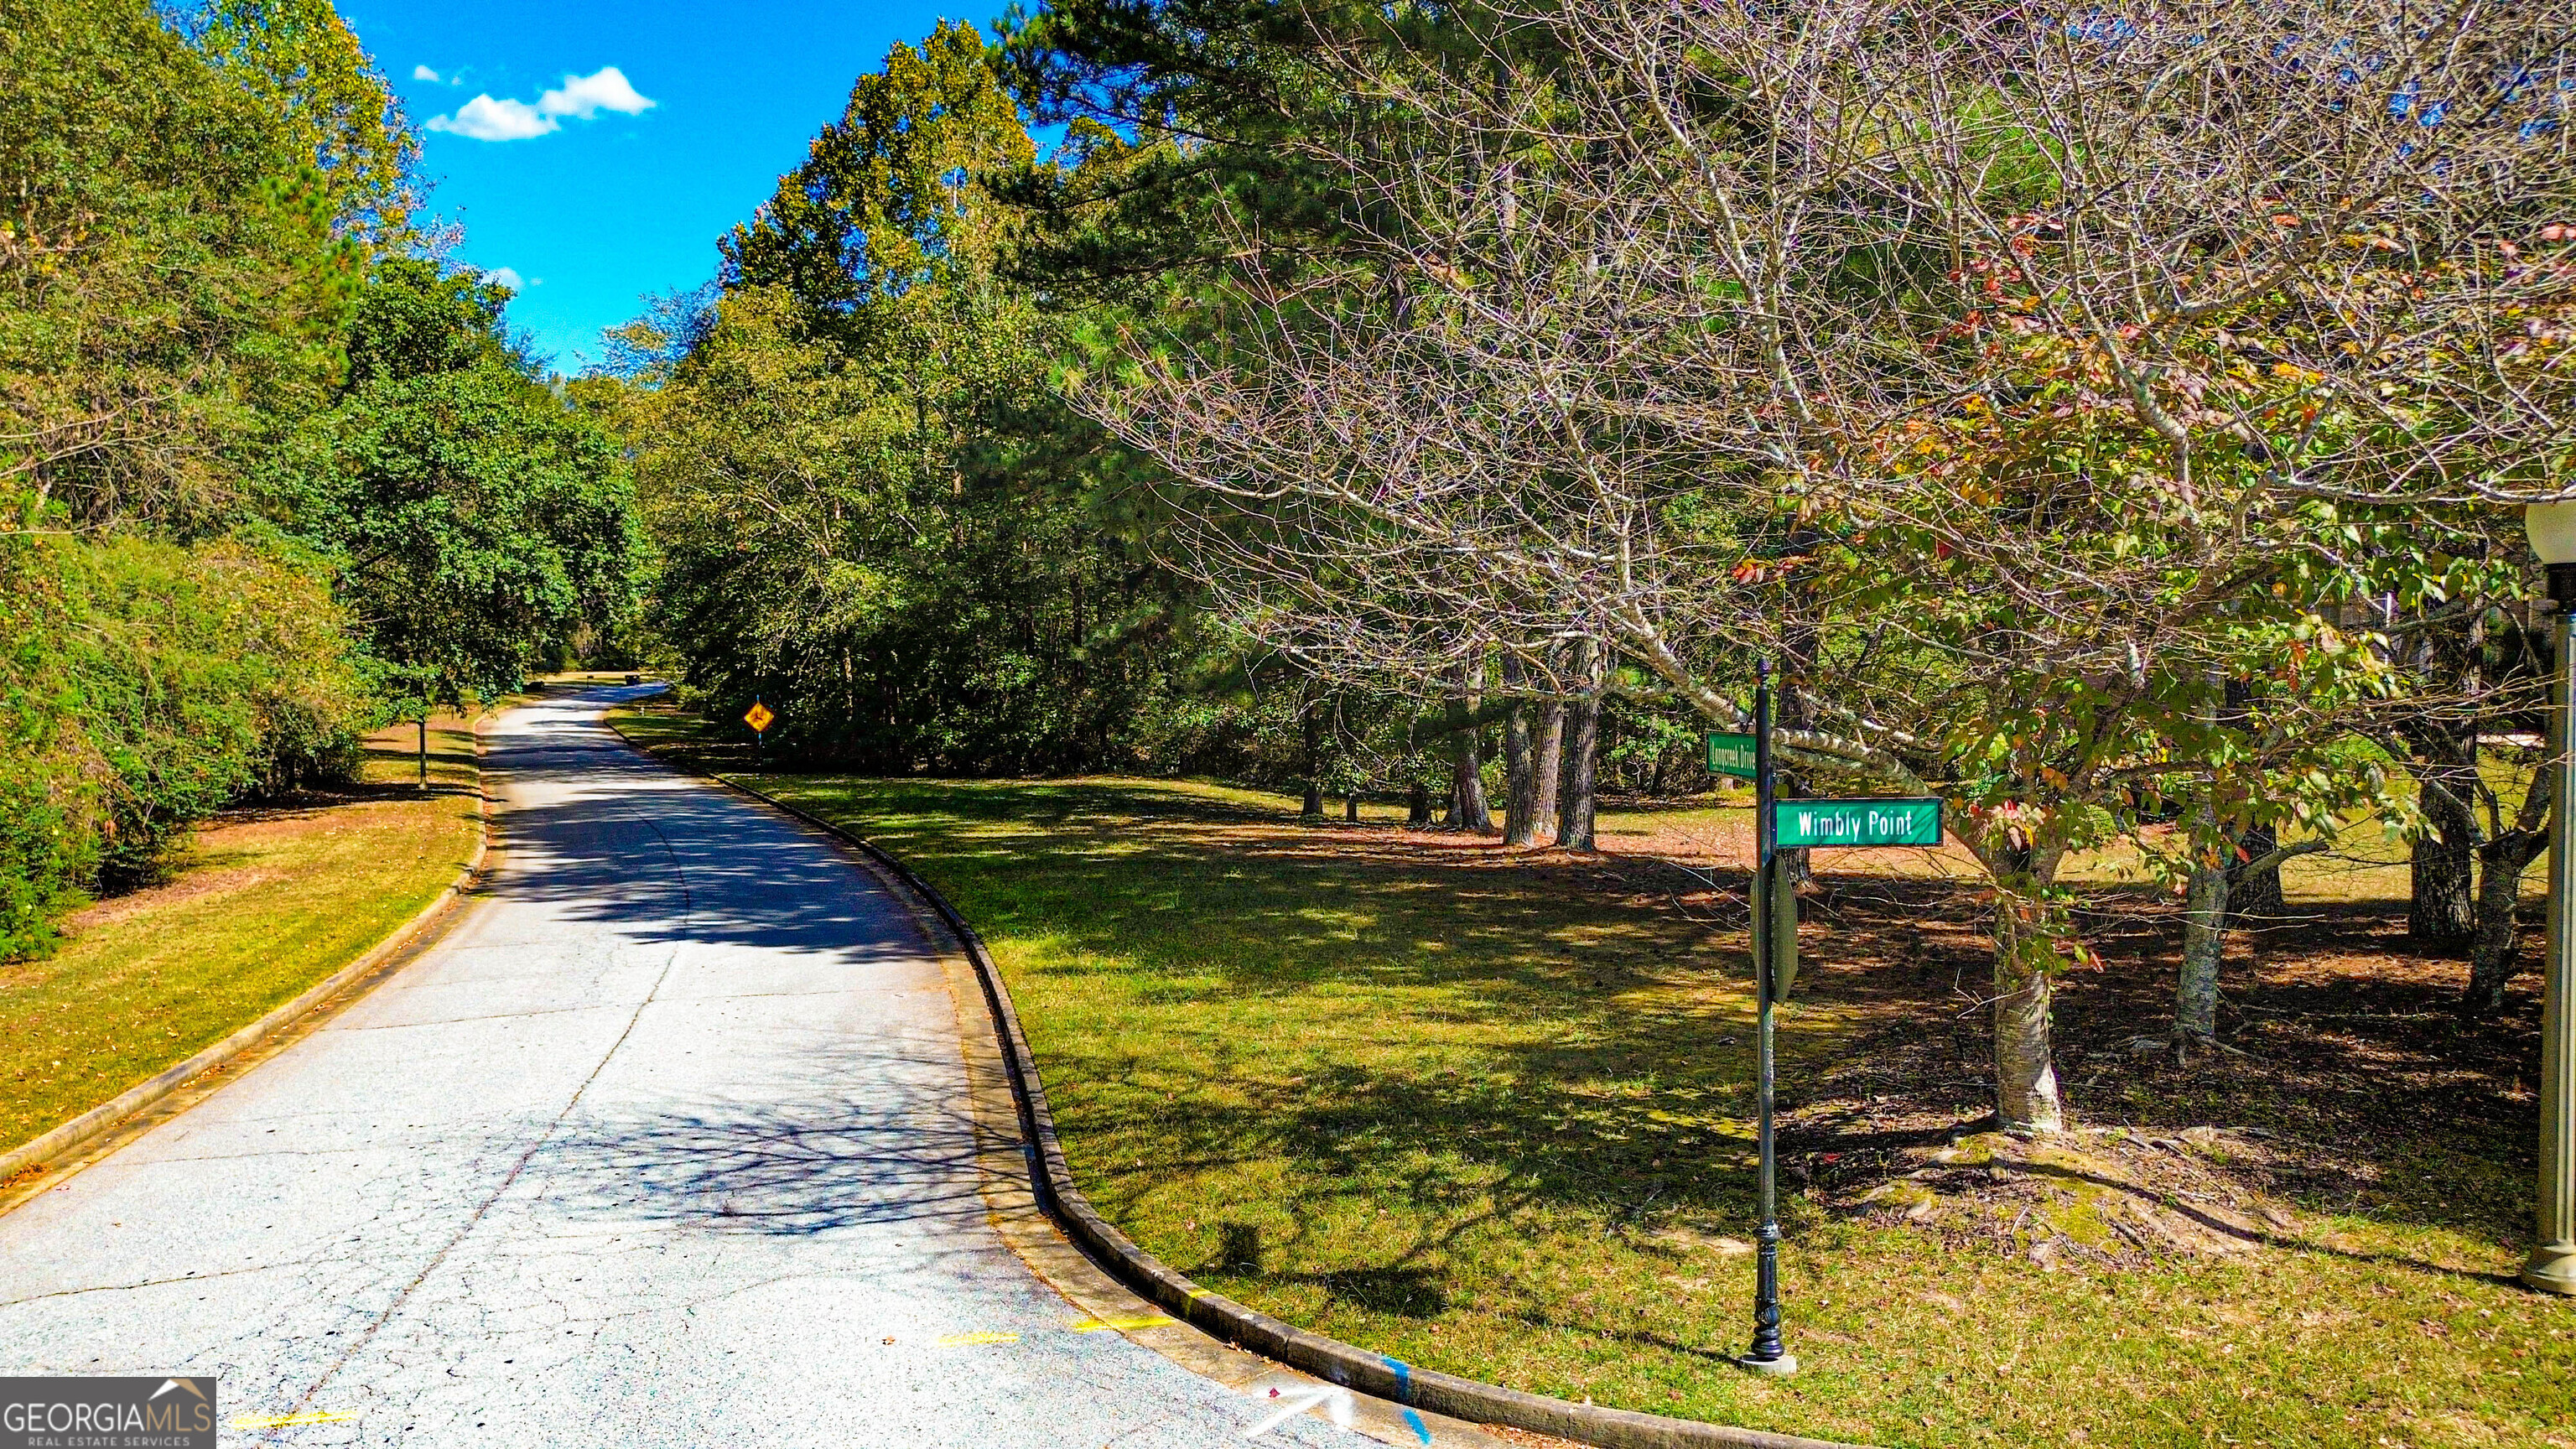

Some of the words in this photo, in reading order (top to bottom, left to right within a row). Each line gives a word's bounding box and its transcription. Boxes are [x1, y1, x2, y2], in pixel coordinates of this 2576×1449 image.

[1740, 745, 1756, 771] Drive
[1799, 811, 1862, 843] Wimbly
[1868, 810, 1913, 836] Point
